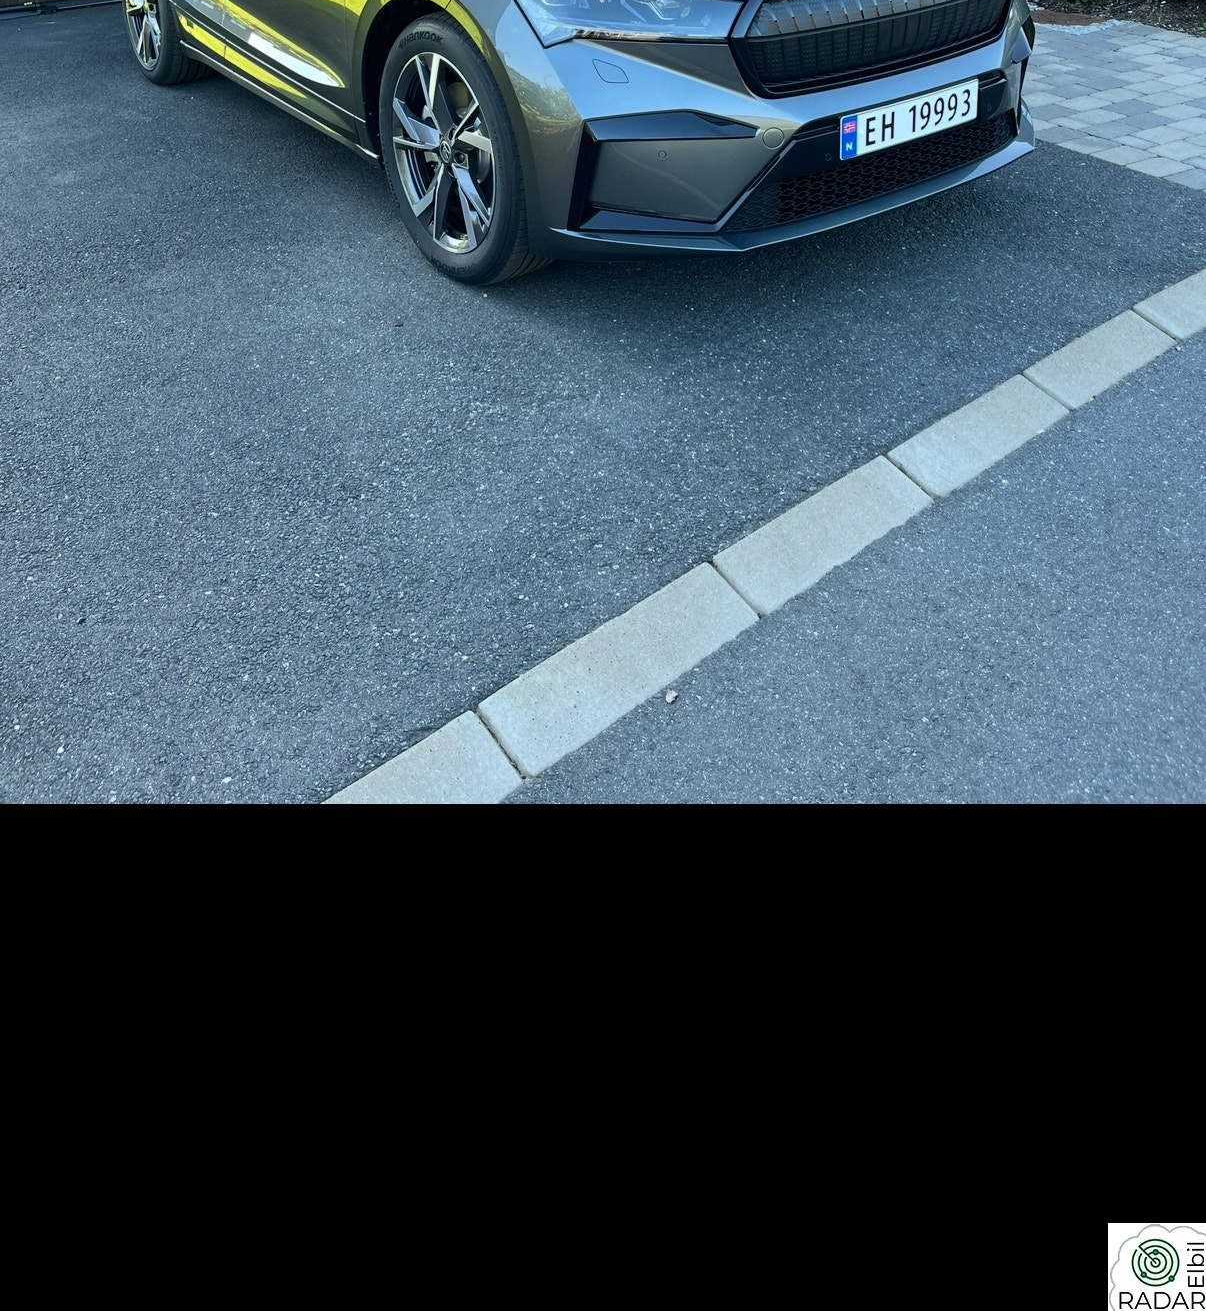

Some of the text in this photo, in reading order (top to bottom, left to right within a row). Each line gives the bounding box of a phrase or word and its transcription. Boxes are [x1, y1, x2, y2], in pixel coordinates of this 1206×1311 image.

[865, 89, 971, 146] EH 19993
[845, 142, 853, 152] N
